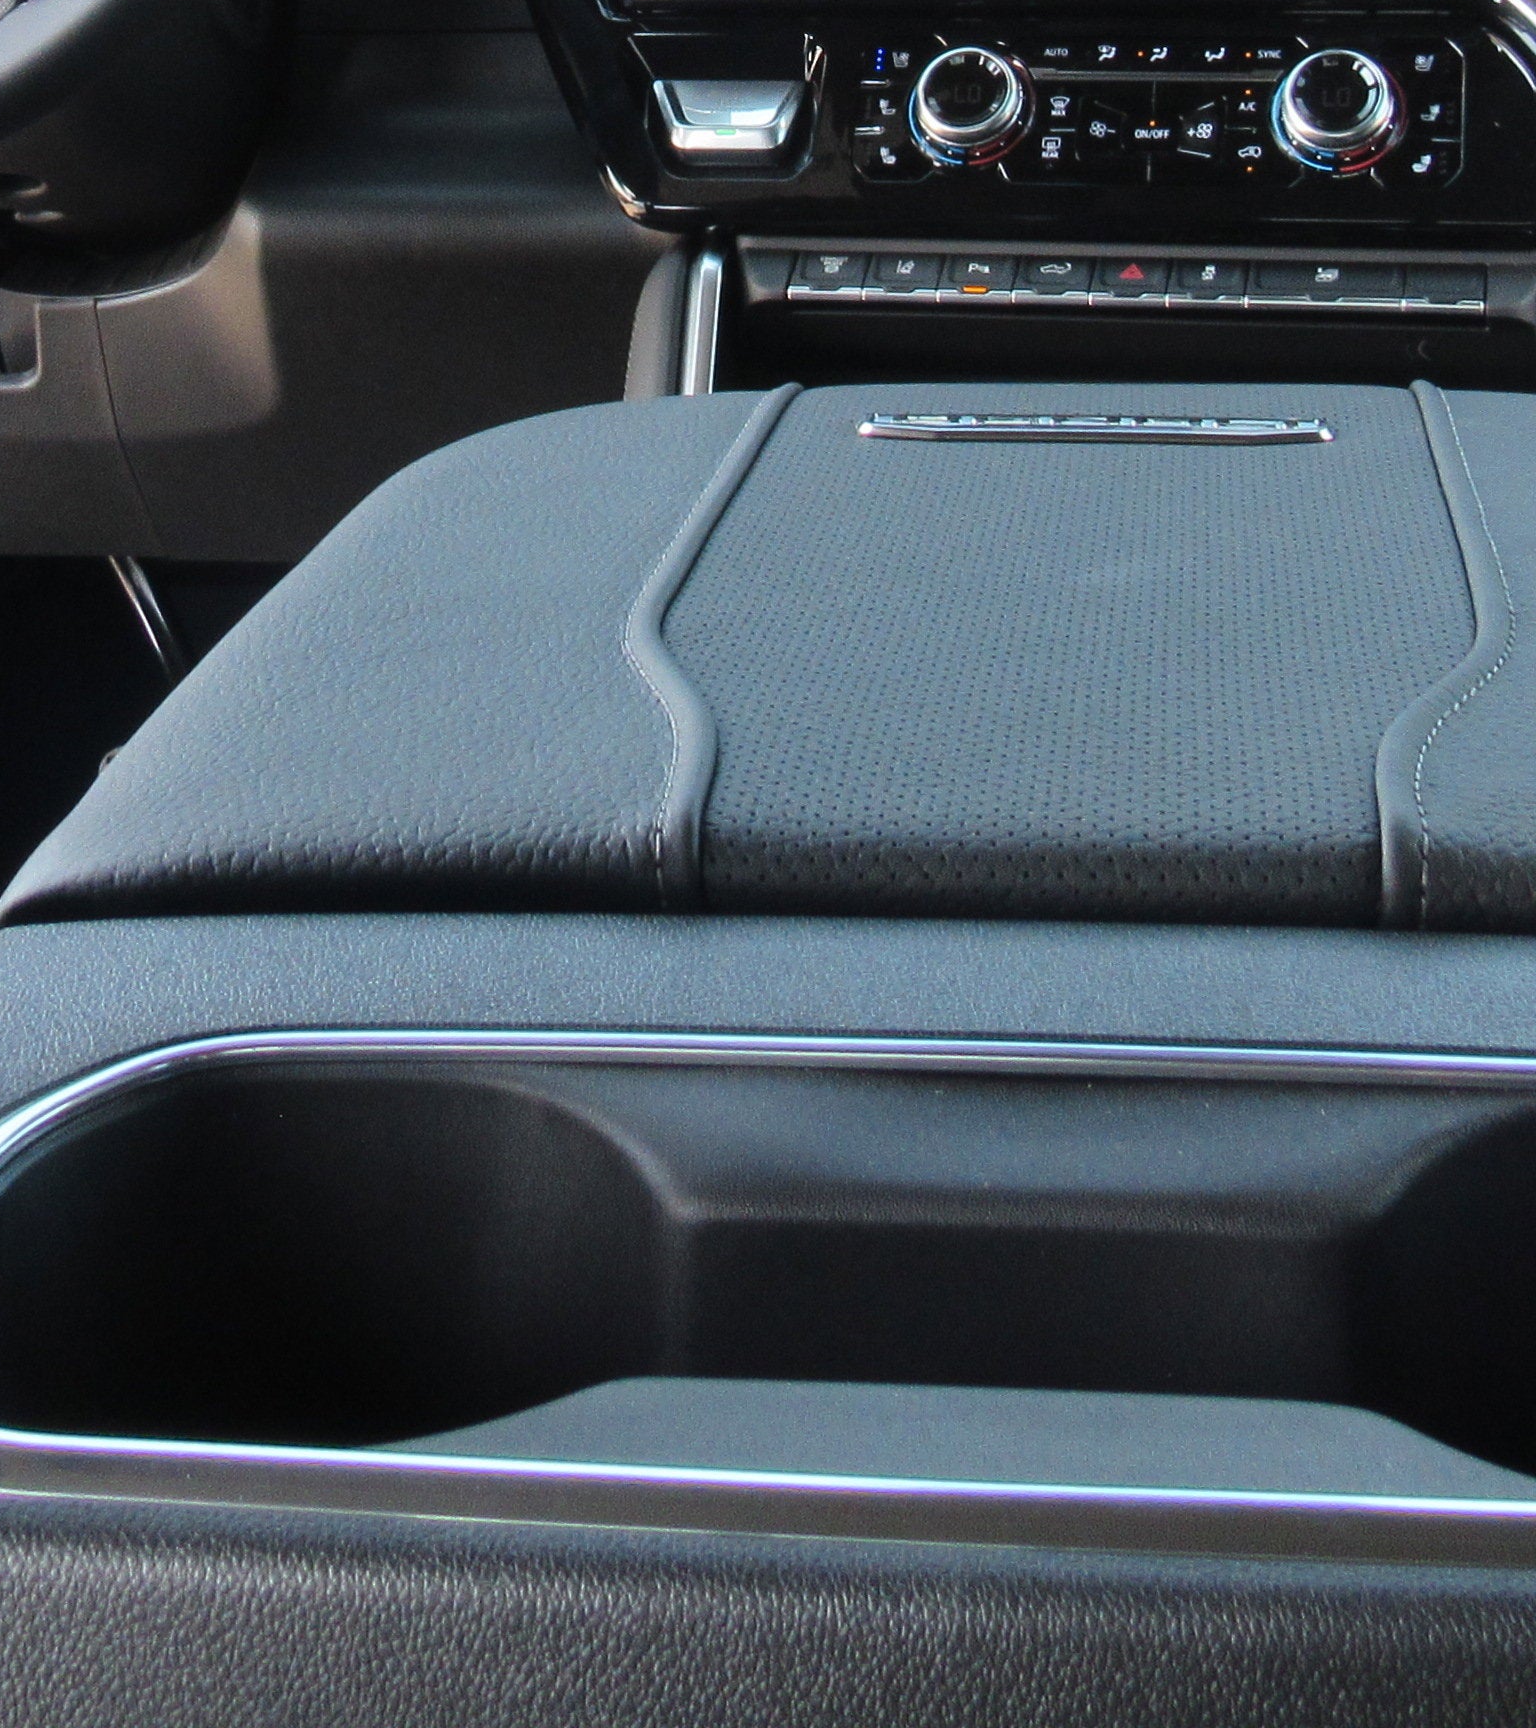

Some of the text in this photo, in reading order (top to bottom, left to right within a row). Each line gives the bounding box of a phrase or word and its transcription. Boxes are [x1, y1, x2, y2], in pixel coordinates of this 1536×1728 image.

[1044, 48, 1069, 57] AUTO
[1257, 50, 1282, 59] SYNC
[1238, 102, 1256, 112] A/C
[1135, 128, 1170, 139] ON/OFF
